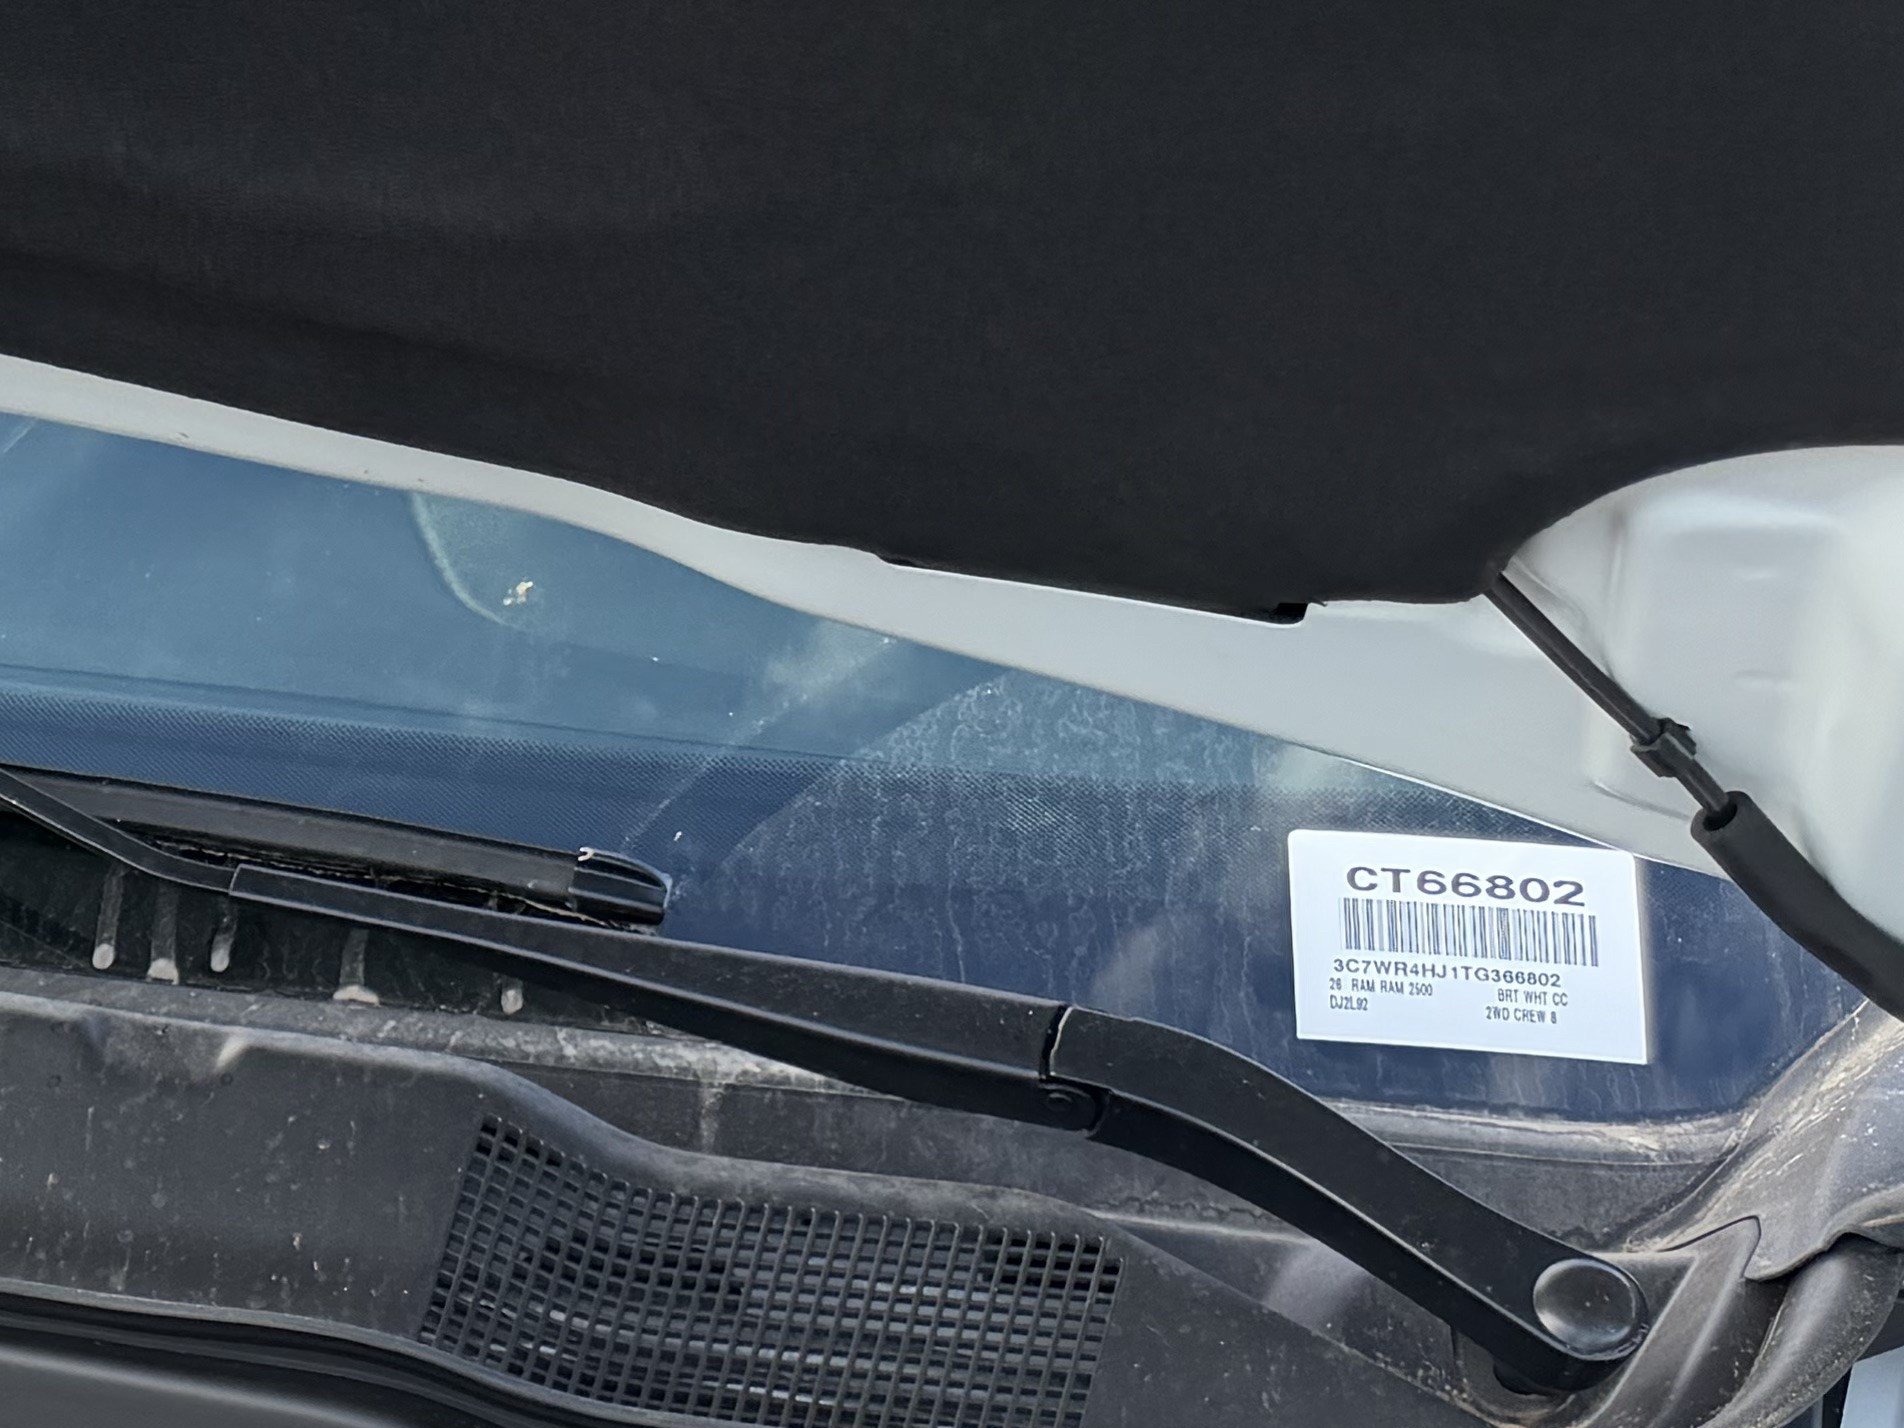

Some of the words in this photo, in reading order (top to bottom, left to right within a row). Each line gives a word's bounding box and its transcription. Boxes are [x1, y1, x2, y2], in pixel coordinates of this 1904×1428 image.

[1345, 865, 1586, 907] CT66802
[1332, 957, 1562, 987] 3C7WR4HJ1TG366802
[1351, 978, 1376, 993] RAM
[1380, 980, 1404, 994] RAM
[1523, 990, 1548, 1005] WHT
[1514, 1008, 1546, 1023] CREW
